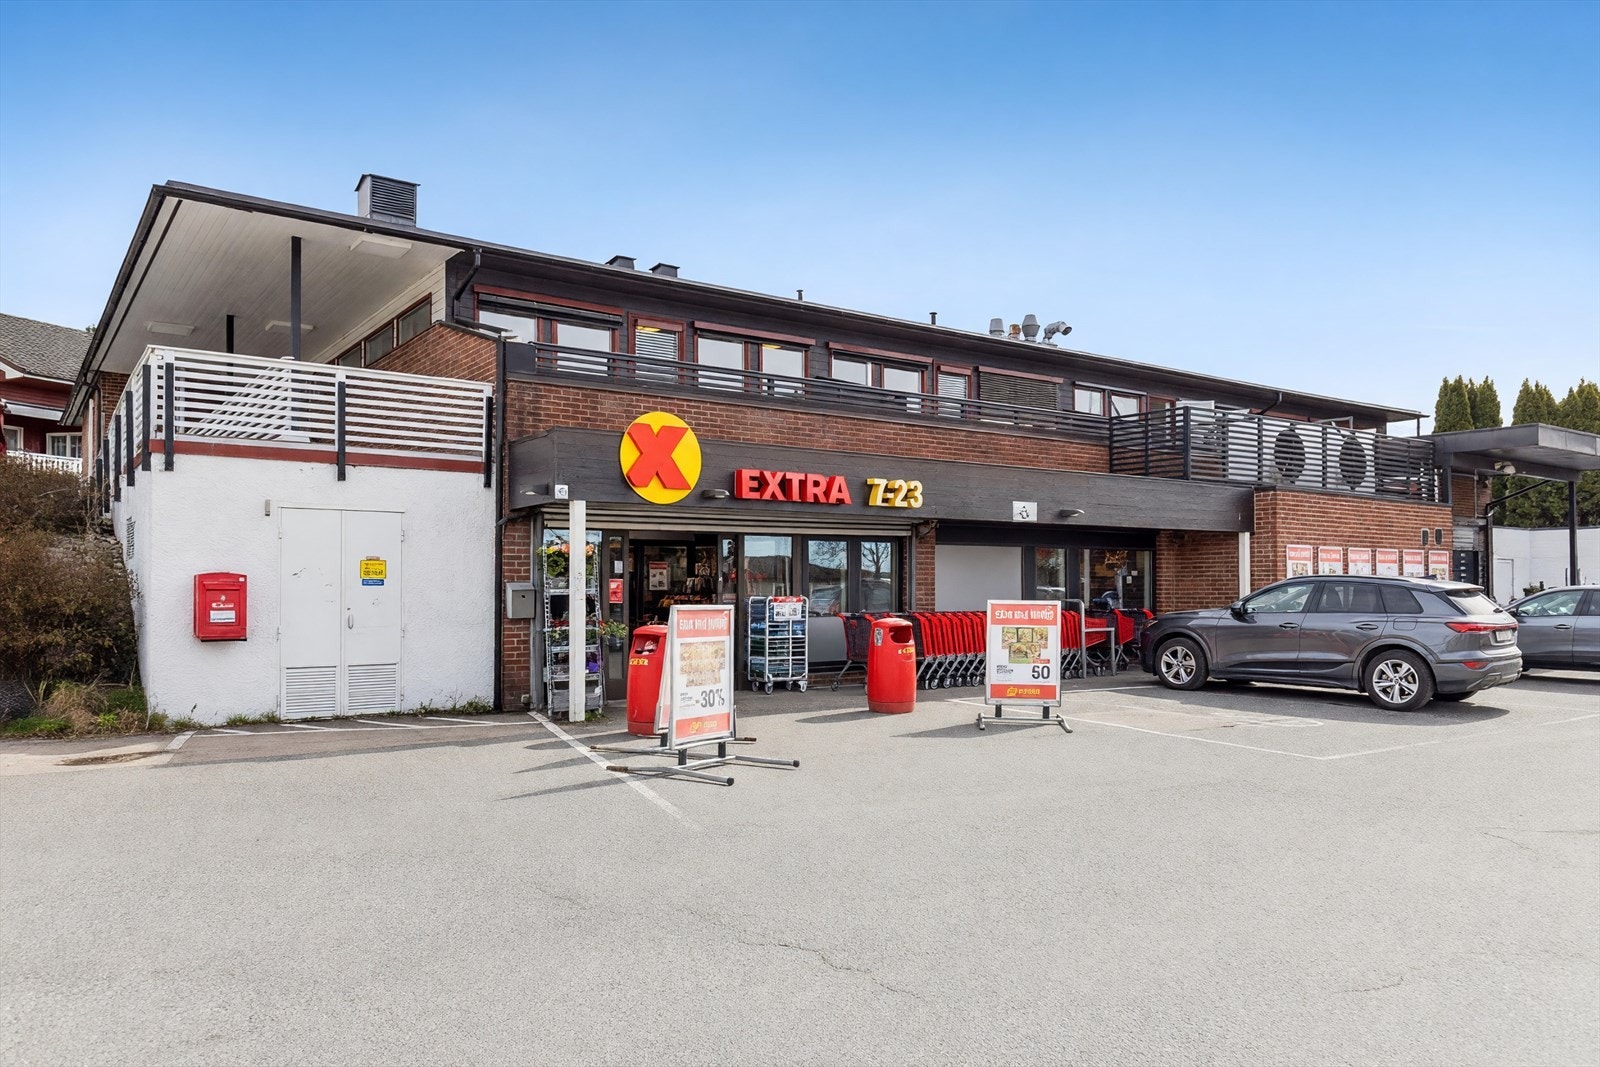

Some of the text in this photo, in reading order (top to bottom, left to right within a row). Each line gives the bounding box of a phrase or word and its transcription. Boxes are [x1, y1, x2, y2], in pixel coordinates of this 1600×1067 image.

[626, 422, 692, 491] X
[735, 468, 924, 509] EXTRA 7-23
